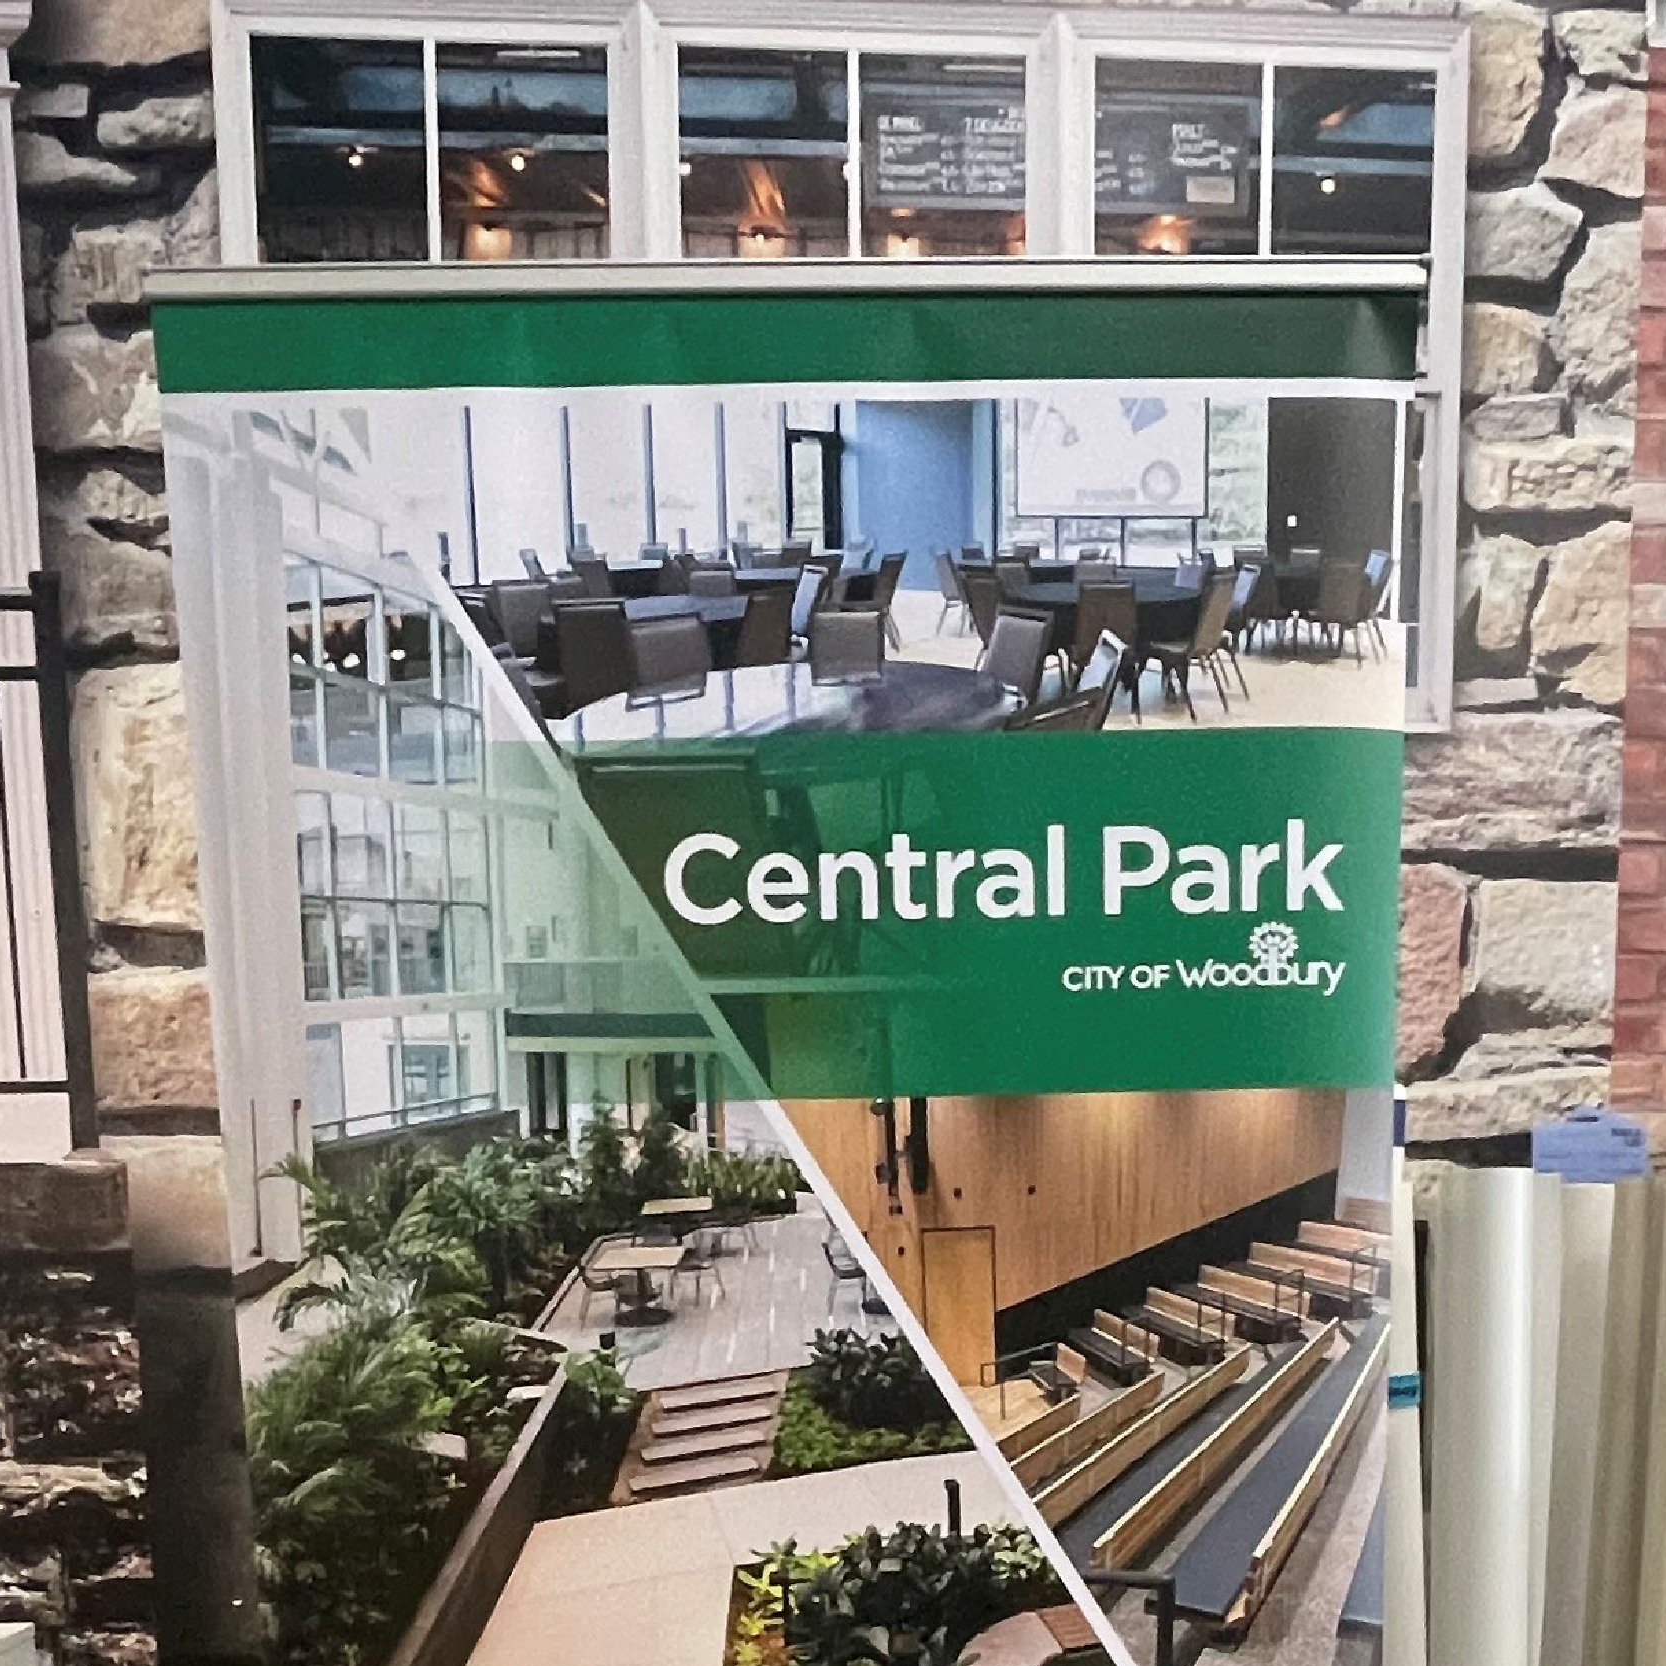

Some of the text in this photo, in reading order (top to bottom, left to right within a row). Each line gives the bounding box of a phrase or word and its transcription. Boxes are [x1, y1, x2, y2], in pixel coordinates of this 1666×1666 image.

[664, 819, 1344, 924] Central Park
[1062, 952, 1346, 996] CITY OF Woodbury
